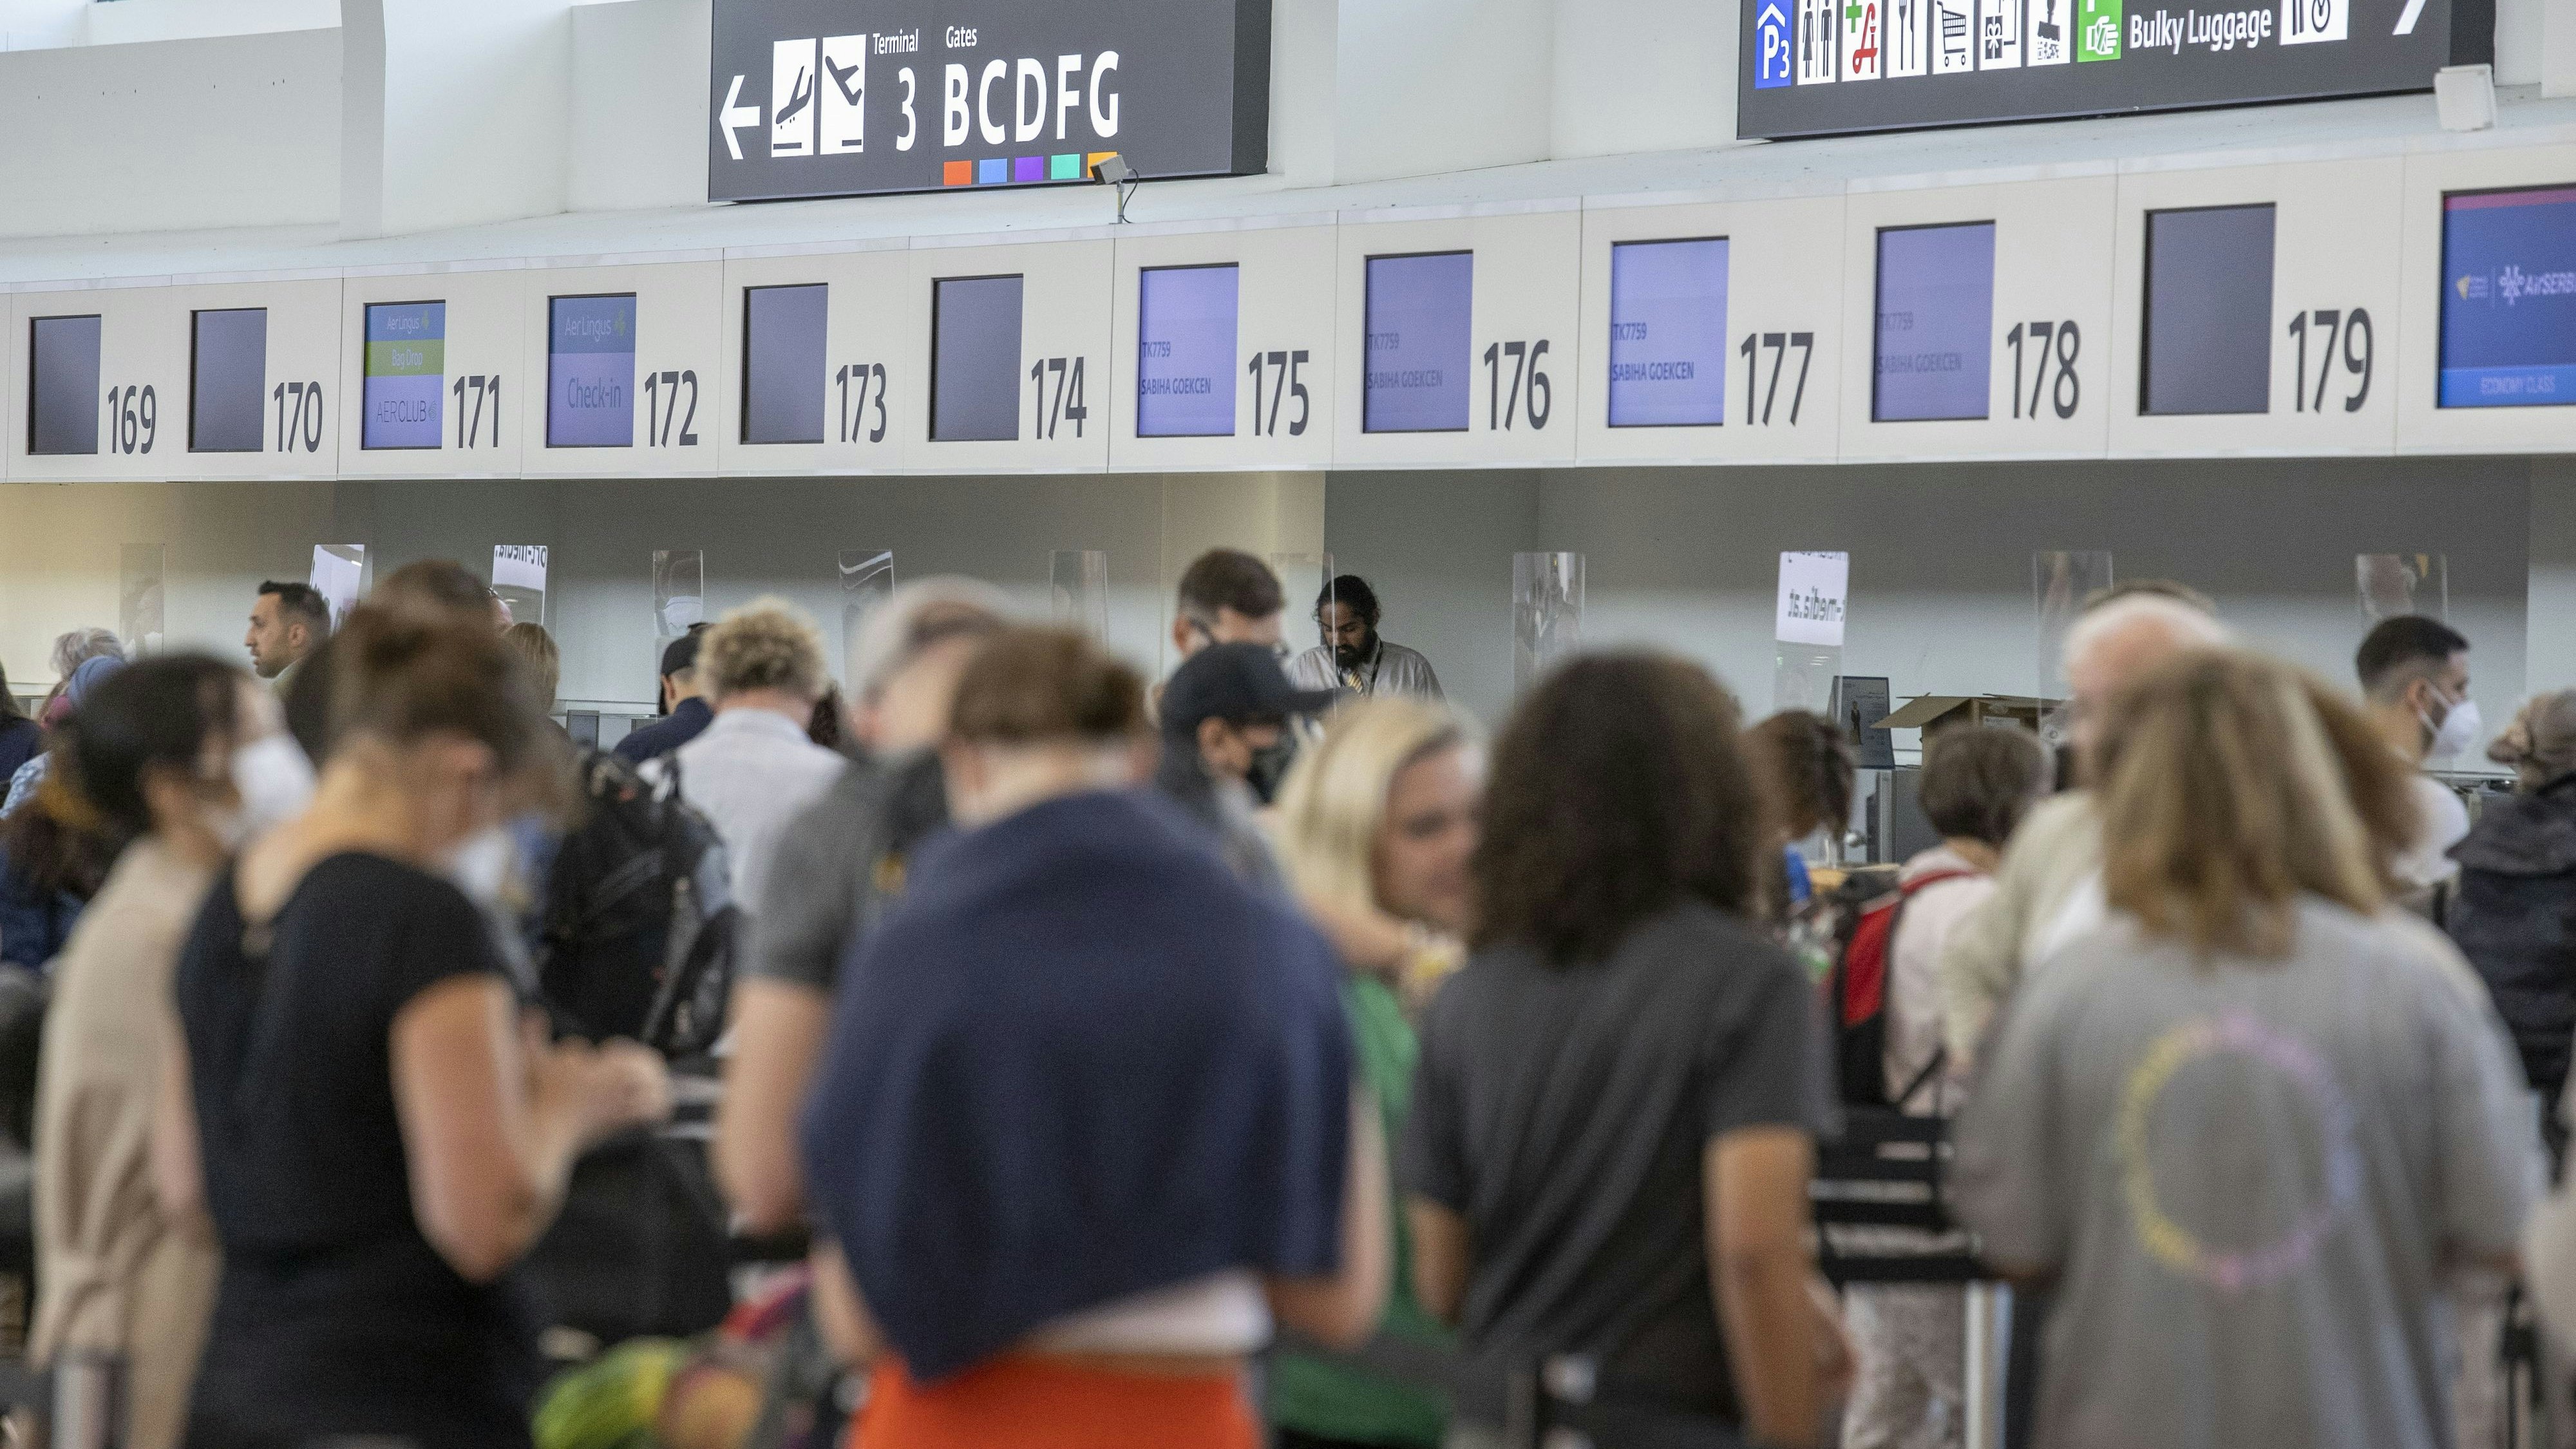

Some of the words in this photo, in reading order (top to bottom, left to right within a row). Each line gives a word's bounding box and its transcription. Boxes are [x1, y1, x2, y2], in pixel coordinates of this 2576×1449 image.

[873, 29, 919, 54] Terminal
[946, 26, 978, 49] Gates
[2130, 10, 2184, 54] Bulky
[2188, 9, 2272, 52] Luggage
[896, 68, 916, 151] 3
[387, 316, 398, 330] Aer
[399, 315, 419, 334] Lingus
[565, 317, 581, 336] Aer
[582, 316, 611, 342] Lingus
[1612, 322, 1647, 340] TK7759
[392, 349, 406, 370] Bag
[406, 348, 423, 368] Drop
[1142, 341, 1171, 358] TK7759
[1612, 364, 1647, 381] SABIHA
[1649, 361, 1694, 380] GOEKCEN
[2007, 320, 2081, 420] 178
[2289, 308, 2374, 414] 179
[567, 378, 621, 408] Check-in
[1031, 356, 1087, 440] 174
[1141, 378, 1171, 395] SABIHA
[1172, 377, 1211, 394] GOEKCEN
[1249, 350, 1310, 437] 175
[1367, 371, 1400, 389] SABIHA
[1401, 370, 1443, 388] GOEKCEN
[1484, 339, 1551, 431] 176
[1741, 332, 1814, 427] 177
[108, 384, 156, 455] 169
[273, 381, 323, 453] 170
[376, 401, 426, 422] AERCLUB
[453, 375, 500, 450] 171
[645, 370, 698, 449] 172
[836, 363, 887, 444] 173
